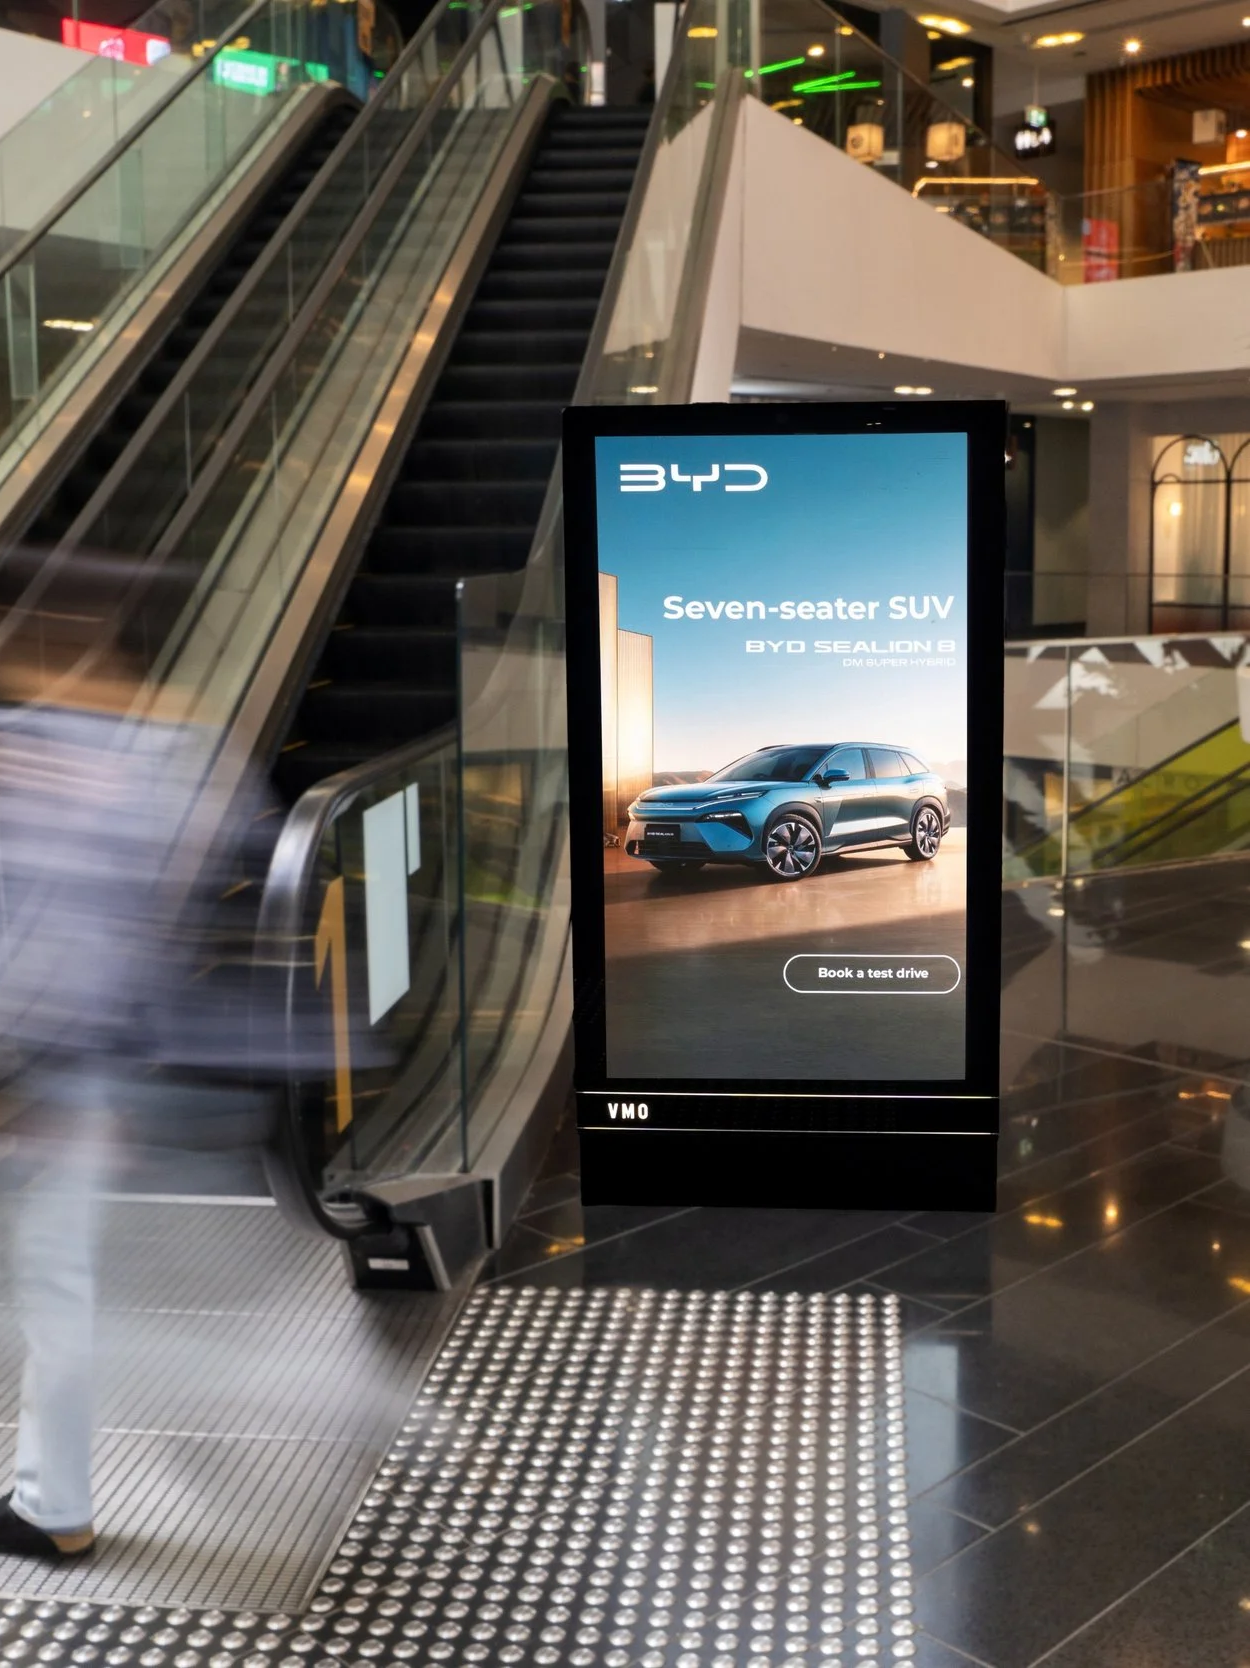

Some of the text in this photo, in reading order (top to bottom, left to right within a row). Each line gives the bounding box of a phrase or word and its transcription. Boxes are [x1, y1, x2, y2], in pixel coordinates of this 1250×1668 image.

[619, 463, 769, 492] BYD
[662, 595, 956, 620] Seven-seater SUV
[745, 640, 956, 654] BYD SEALION 8
[866, 657, 908, 668] SUPER
[909, 657, 956, 668] HYBRID
[818, 967, 853, 978] Book
[867, 968, 893, 979] test
[896, 967, 929, 979] drive
[607, 1103, 649, 1119] VMO
